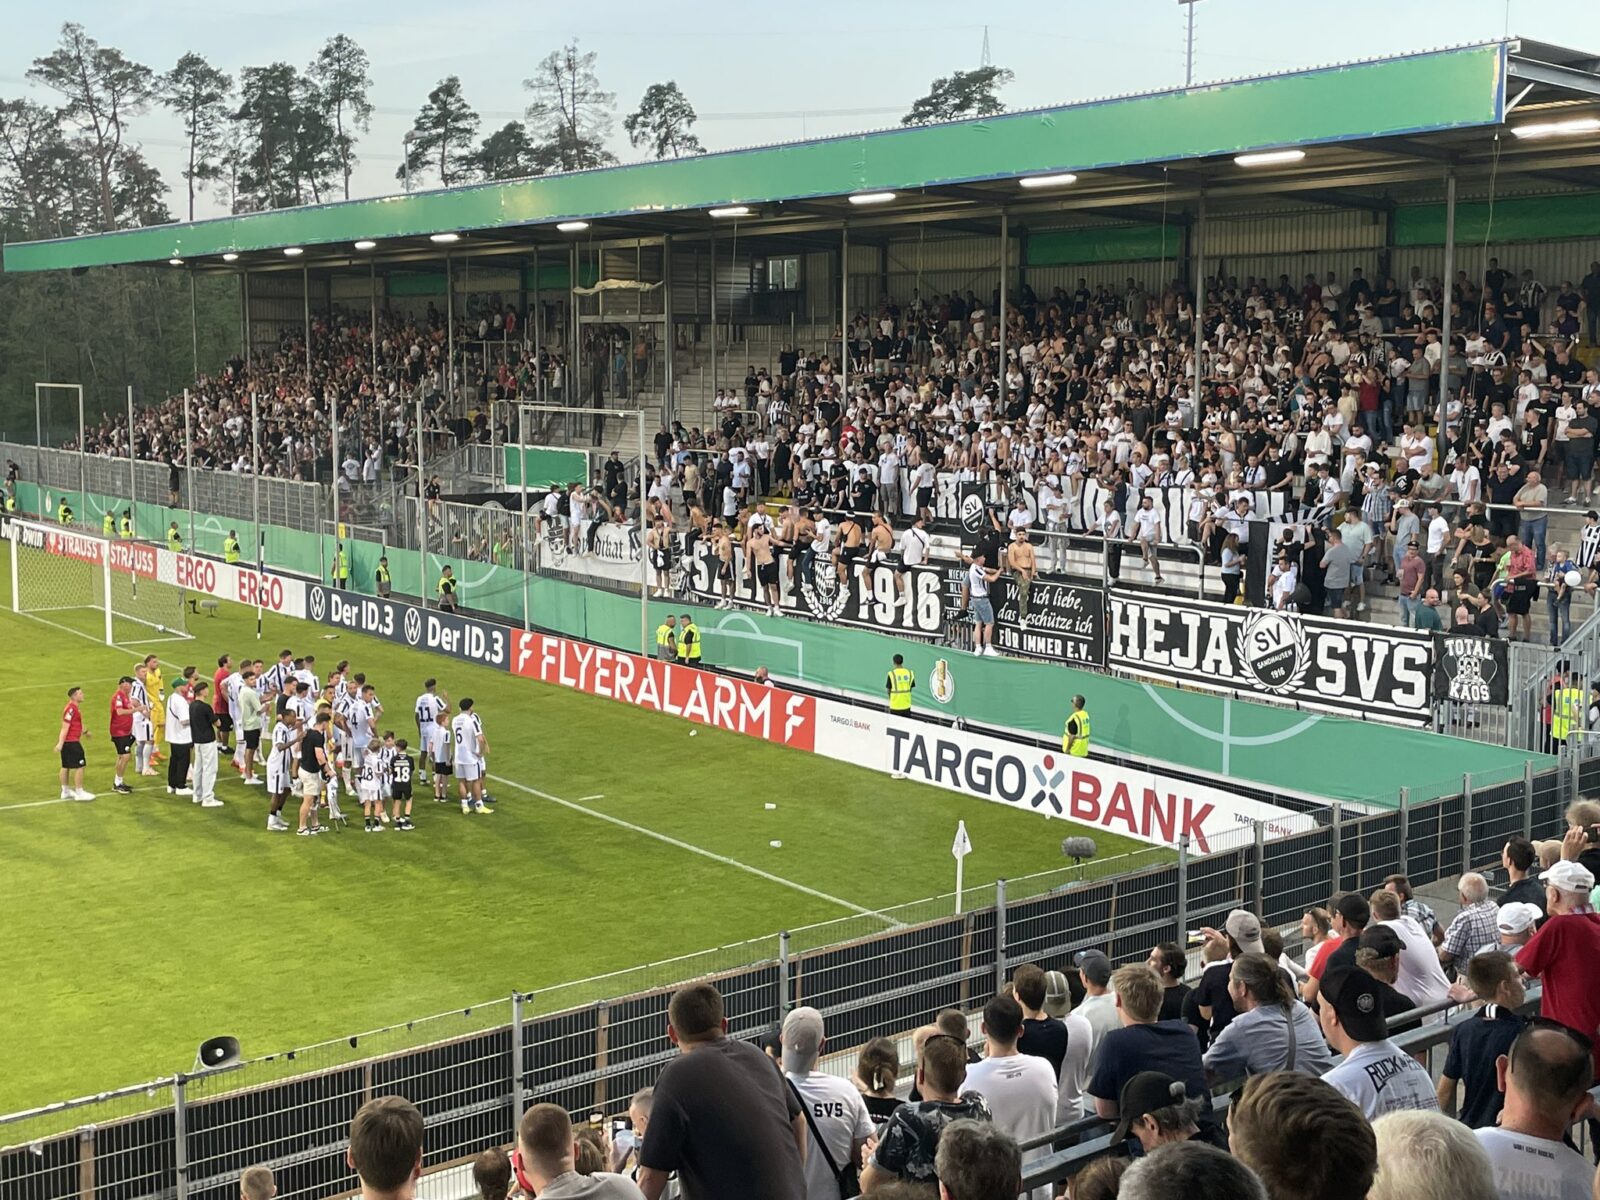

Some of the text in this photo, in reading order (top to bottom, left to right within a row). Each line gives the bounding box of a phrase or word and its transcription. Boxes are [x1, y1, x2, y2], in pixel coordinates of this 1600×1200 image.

[964, 498, 977, 515] SV
[22, 526, 43, 548] bwin
[58, 534, 97, 560] STRAUSS
[110, 544, 154, 573] STRAUSS
[176, 554, 216, 593] ERGO
[238, 569, 283, 611] ERGO
[853, 564, 941, 631] 1916
[1033, 585, 1050, 606] ich
[1053, 587, 1084, 613] liebe,
[331, 593, 394, 636] Der ID.3
[997, 602, 1017, 622] das
[1075, 614, 1094, 634] ich
[427, 616, 504, 664] Der ID.3
[998, 627, 1093, 661] FÜR IMMER E.V.
[1254, 622, 1282, 652] SV
[1444, 639, 1495, 661] TOTAL
[1110, 600, 1428, 709] HEJA SVS
[1256, 648, 1293, 670] SANDHAUSEN
[1270, 666, 1286, 679] 1916
[541, 636, 771, 740] FLYERALARM
[1449, 680, 1490, 702] KAOS
[418, 706, 434, 723] 11
[394, 766, 410, 783] 18
[886, 727, 1216, 854] TARGO BANK
[1363, 1055, 1405, 1094] ROCK
[814, 1102, 844, 1118] SVS
